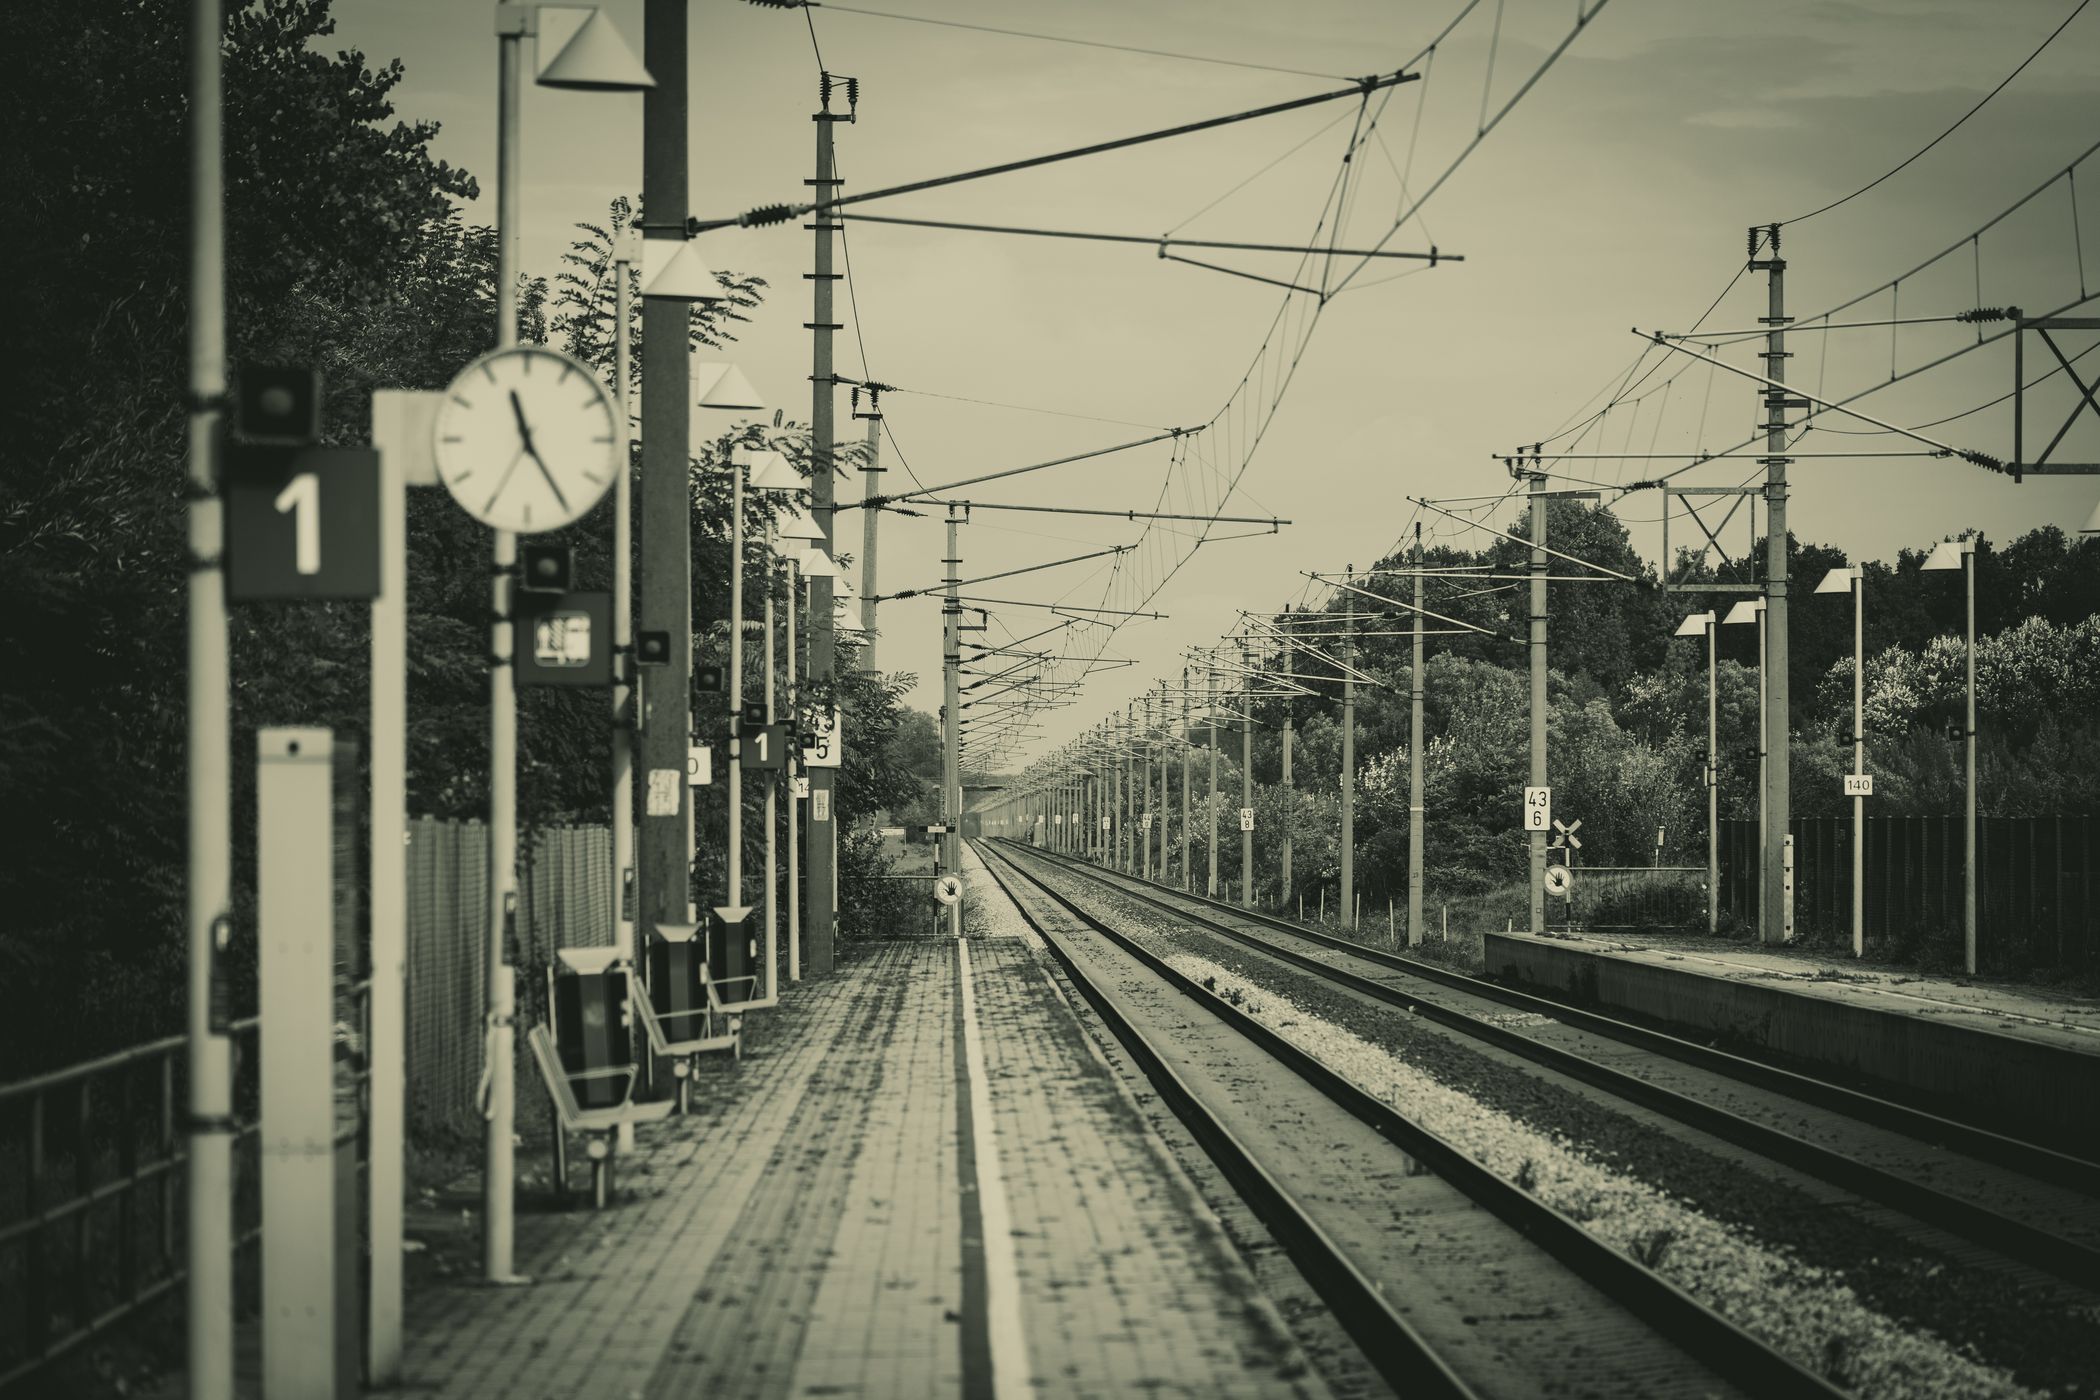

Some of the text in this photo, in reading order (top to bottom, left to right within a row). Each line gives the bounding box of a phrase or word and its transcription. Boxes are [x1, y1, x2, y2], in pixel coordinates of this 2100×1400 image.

[274, 474, 321, 575] 1
[755, 732, 767, 762] 1
[816, 736, 828, 759] 5
[1847, 780, 1870, 790] 140
[1528, 791, 1547, 807] 43
[1242, 810, 1252, 819] 43
[1533, 811, 1542, 826] 6
[1245, 820, 1250, 828] 8
